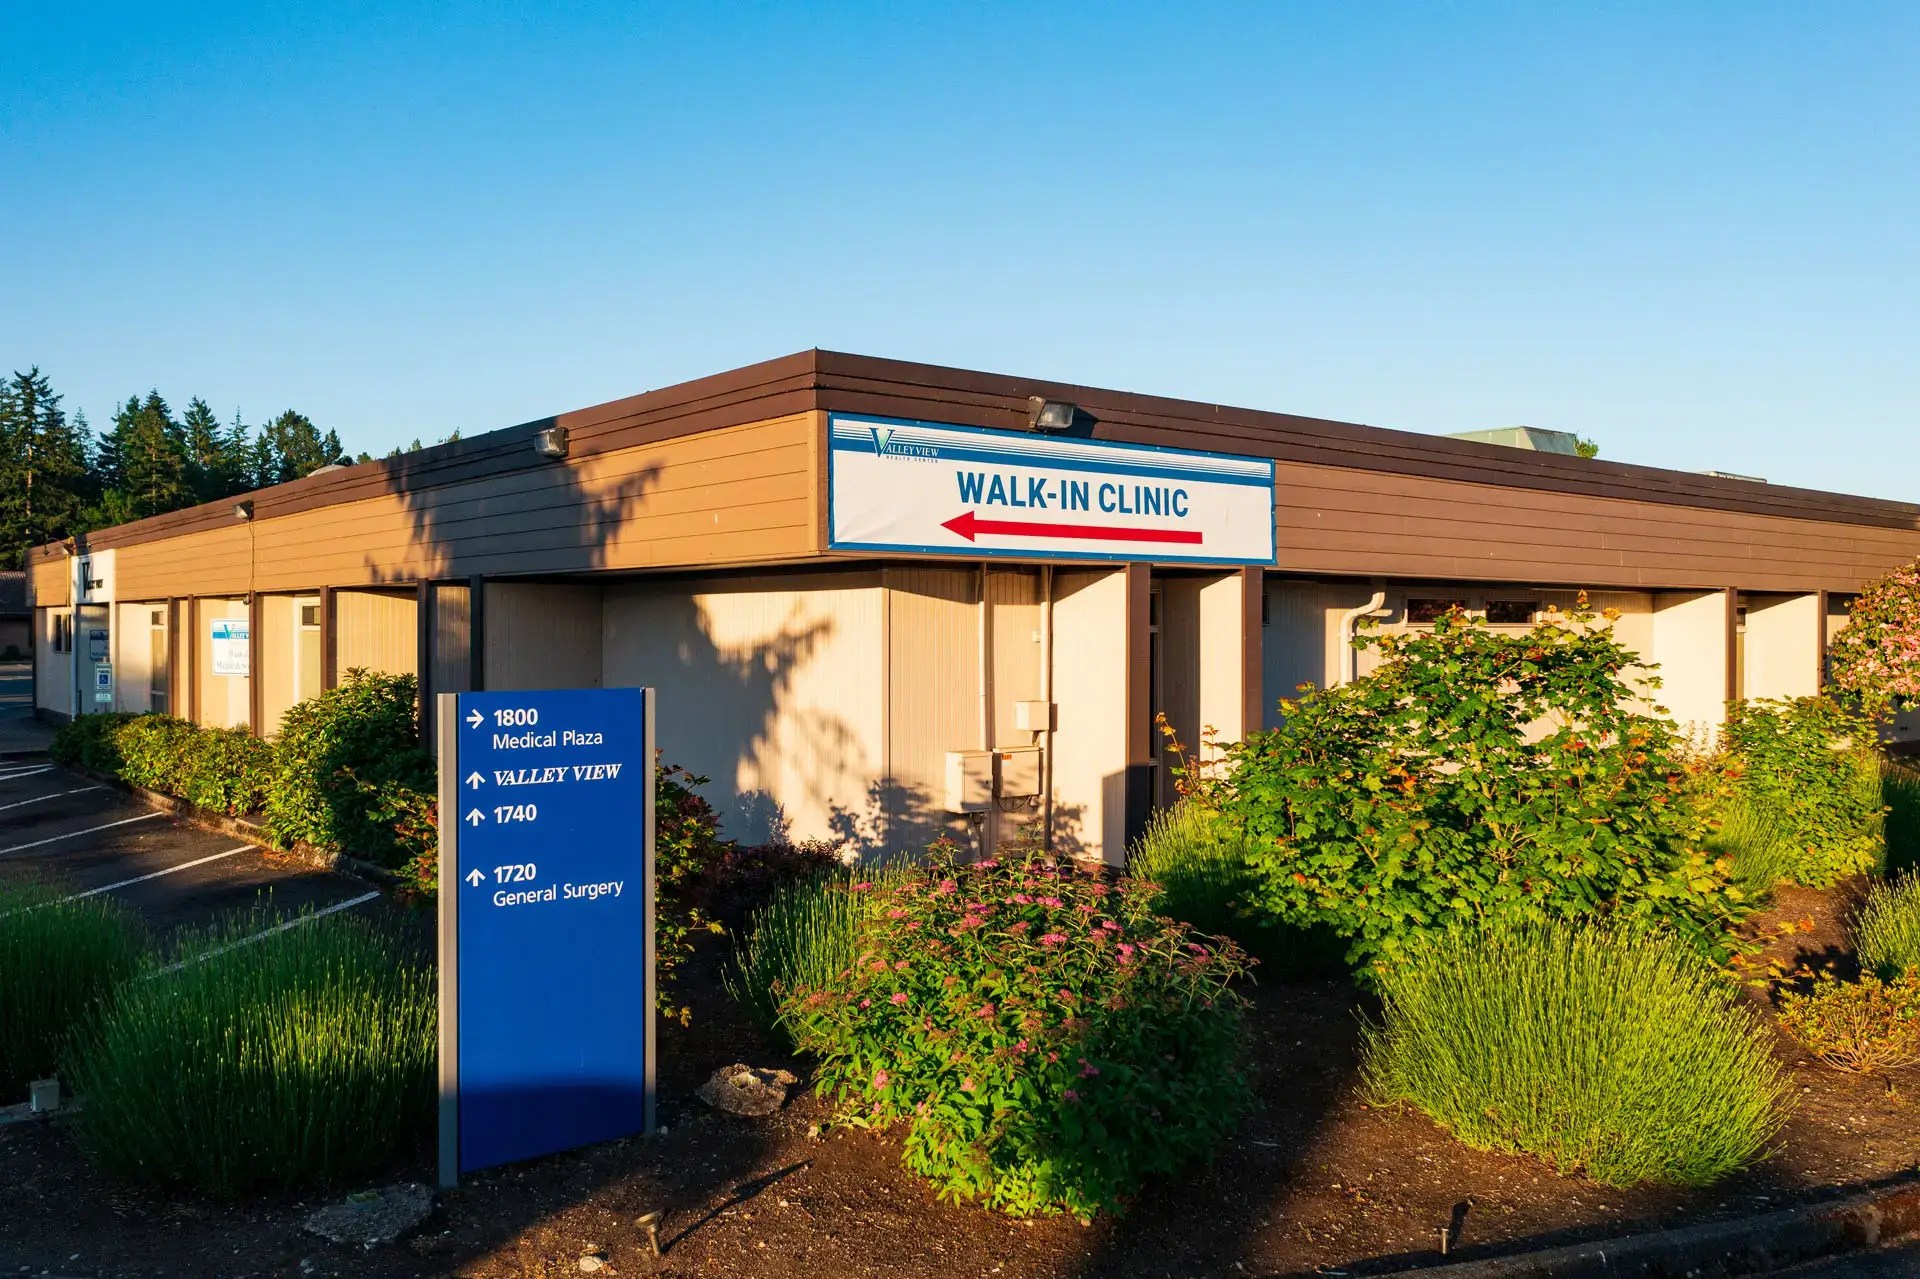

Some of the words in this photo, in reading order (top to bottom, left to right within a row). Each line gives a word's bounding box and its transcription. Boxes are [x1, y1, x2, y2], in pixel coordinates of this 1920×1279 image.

[869, 427, 914, 458] VALLEY
[916, 446, 940, 457] VIEW
[957, 471, 1090, 511] WALK-IN
[1098, 482, 1190, 518] CLINIC
[494, 708, 538, 727] 1800
[493, 730, 556, 750] Medical
[562, 730, 603, 746] Plaza
[494, 766, 569, 786] VALLEY
[573, 763, 622, 781] VIEW
[494, 803, 537, 823] 1740
[494, 863, 536, 883] 1720
[493, 884, 556, 907] General
[563, 880, 624, 900] Surgery
